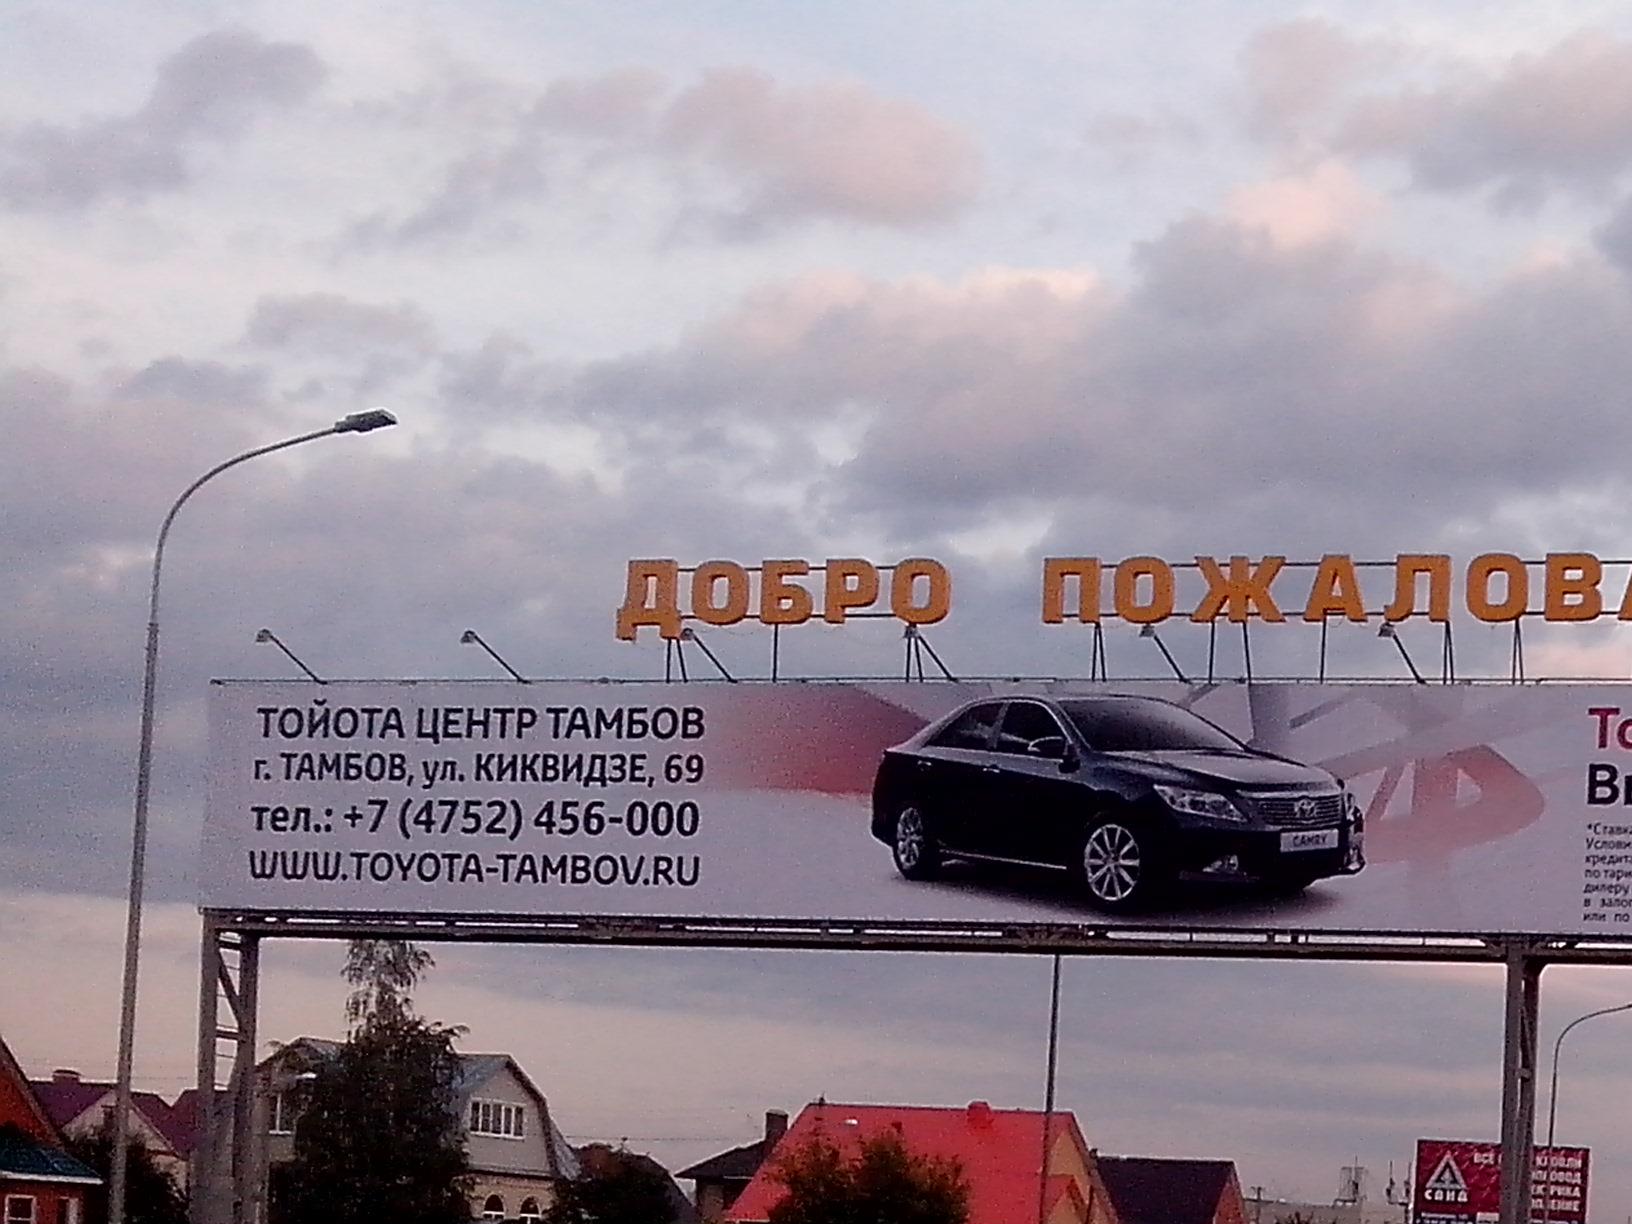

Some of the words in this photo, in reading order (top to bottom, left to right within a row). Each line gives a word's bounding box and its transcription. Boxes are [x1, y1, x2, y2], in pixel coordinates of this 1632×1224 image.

[615, 556, 951, 641] ДОБРО
[257, 698, 405, 739] ТОЙОТА
[416, 706, 538, 745] ЦЕНТР
[546, 706, 705, 740] ТАМБОВ
[253, 759, 271, 781] г.
[280, 752, 414, 787] ТАМБОВ,
[422, 760, 465, 790] ул.
[474, 753, 655, 788] КИКВИДЗЕ,
[664, 753, 704, 784] 69
[251, 805, 333, 833] тел.:
[343, 799, 389, 833] +7
[398, 797, 523, 842] (4752)
[534, 800, 700, 837] 456-000
[249, 850, 700, 886] WWW.TOYOTA-TAMBOV.RU
[1584, 869, 1600, 878] по
[1584, 883, 1630, 895] дилеру
[1583, 912, 1606, 921] или
[1614, 913, 1630, 922] по
